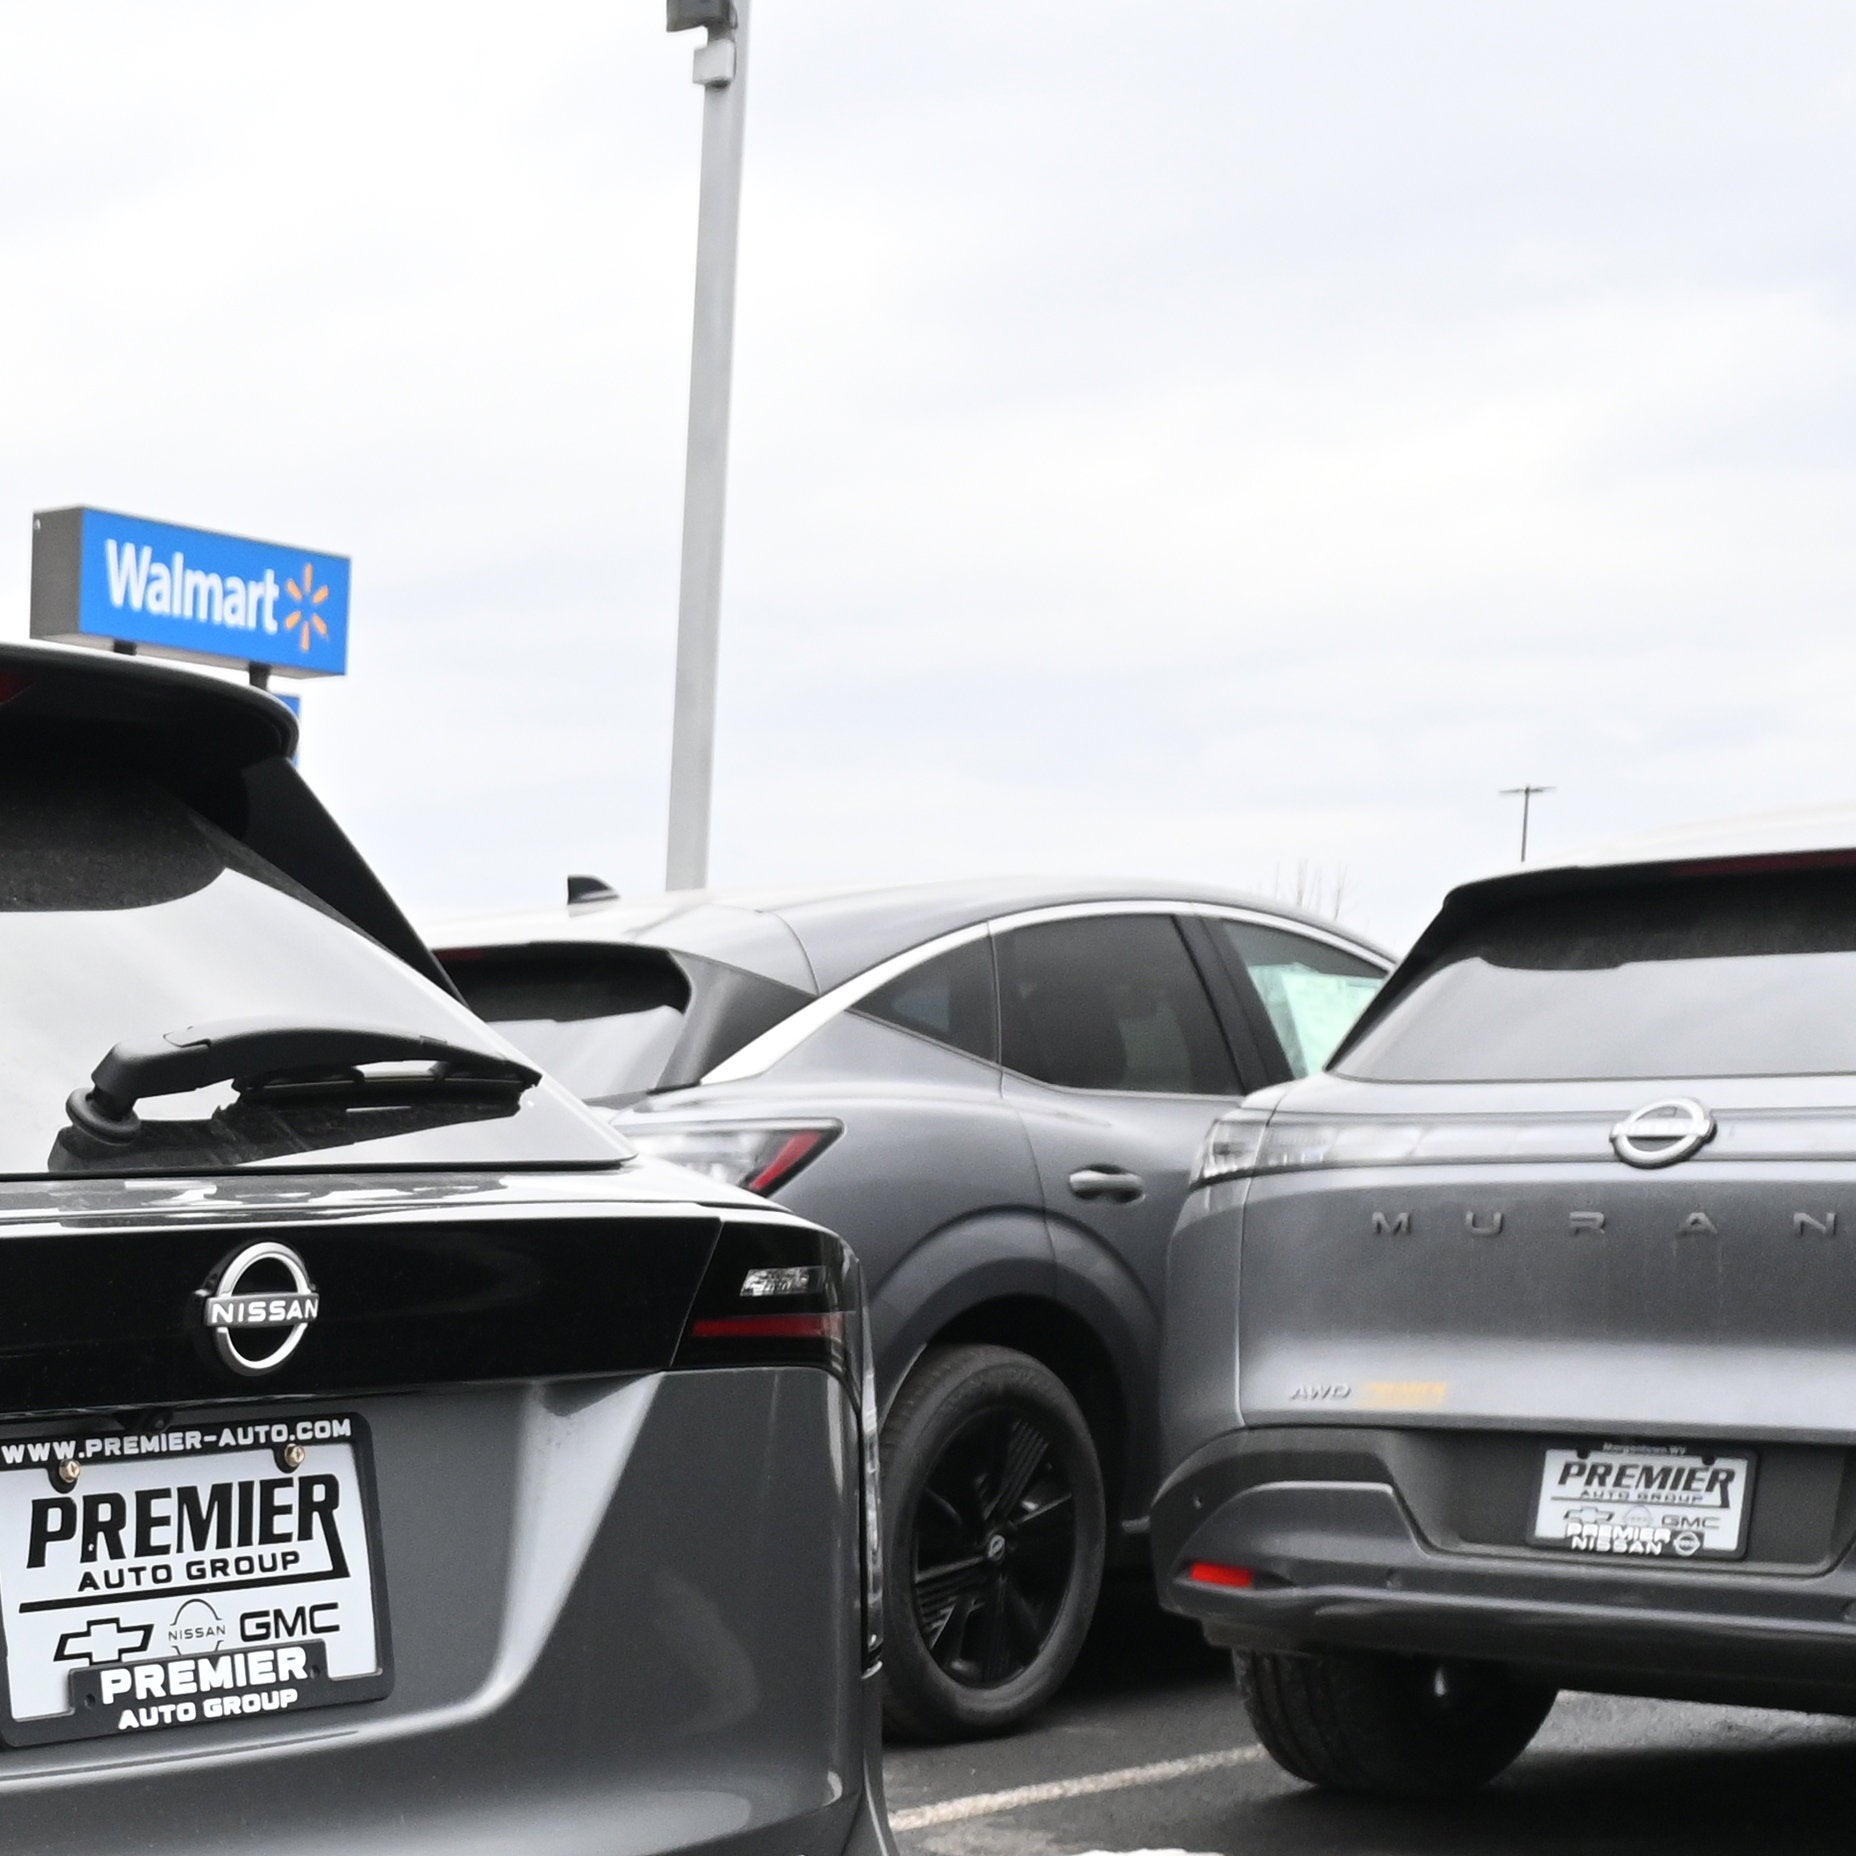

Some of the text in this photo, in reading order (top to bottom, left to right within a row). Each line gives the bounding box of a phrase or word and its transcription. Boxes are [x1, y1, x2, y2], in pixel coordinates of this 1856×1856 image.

[105, 538, 280, 635] Walmart
[211, 1298, 320, 1324] NISSAN
[1290, 1382, 1352, 1400] AWD
[0, 1419, 352, 1465] WWW.PREMIER-AUTO.COM
[1557, 1460, 1735, 1497] PREMIER
[1580, 1489, 1703, 1504] AUTO GROUP
[26, 1472, 342, 1574] PREMIER
[1566, 1522, 1672, 1544] PREMIER
[1661, 1514, 1721, 1529] GMC
[1571, 1535, 1664, 1556] NISSAN
[78, 1550, 301, 1593] AUTO GROUP
[168, 1602, 341, 1643] NISSAN GMC
[100, 1646, 309, 1705] PREMIER
[118, 1688, 299, 1731] AUTO GROUP
